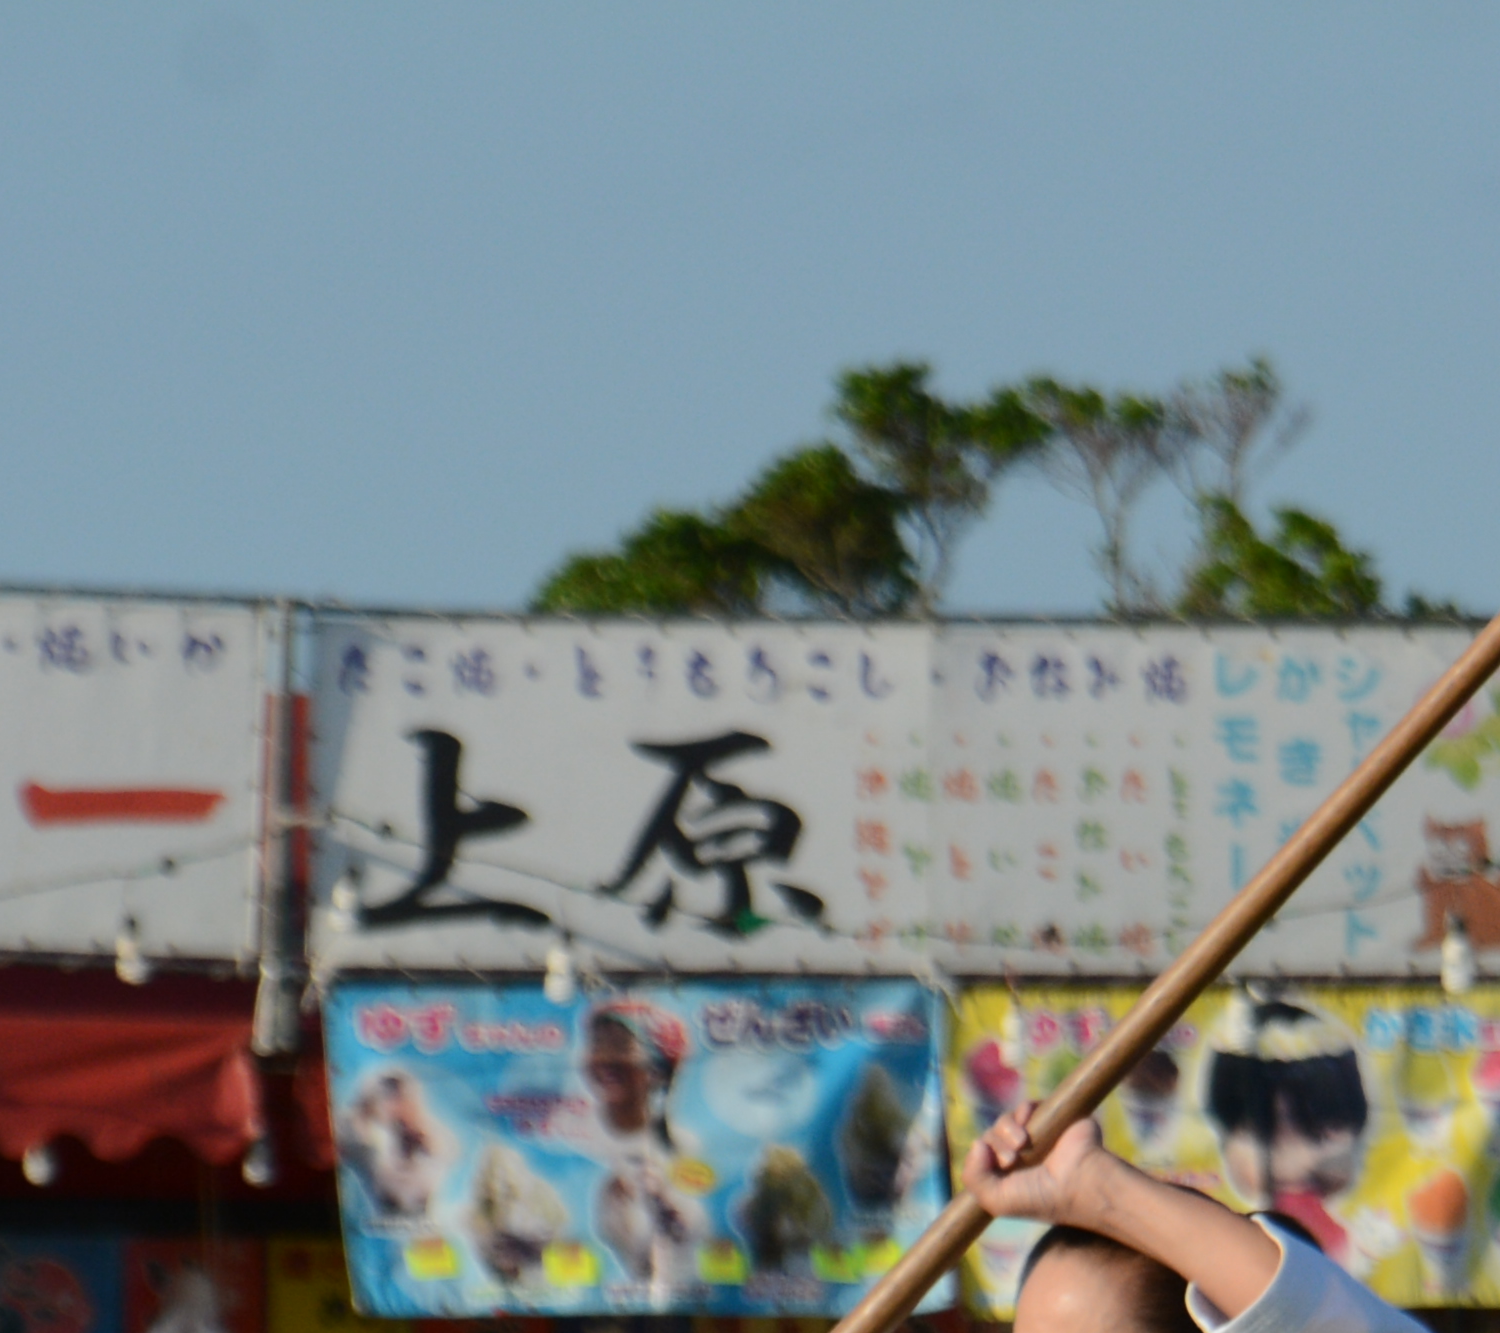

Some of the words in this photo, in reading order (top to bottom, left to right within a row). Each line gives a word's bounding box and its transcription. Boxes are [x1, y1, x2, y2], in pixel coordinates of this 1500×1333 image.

[358, 728, 831, 937] 上原
[1212, 650, 1261, 891] レモネー
[1334, 656, 1384, 958] シャット
